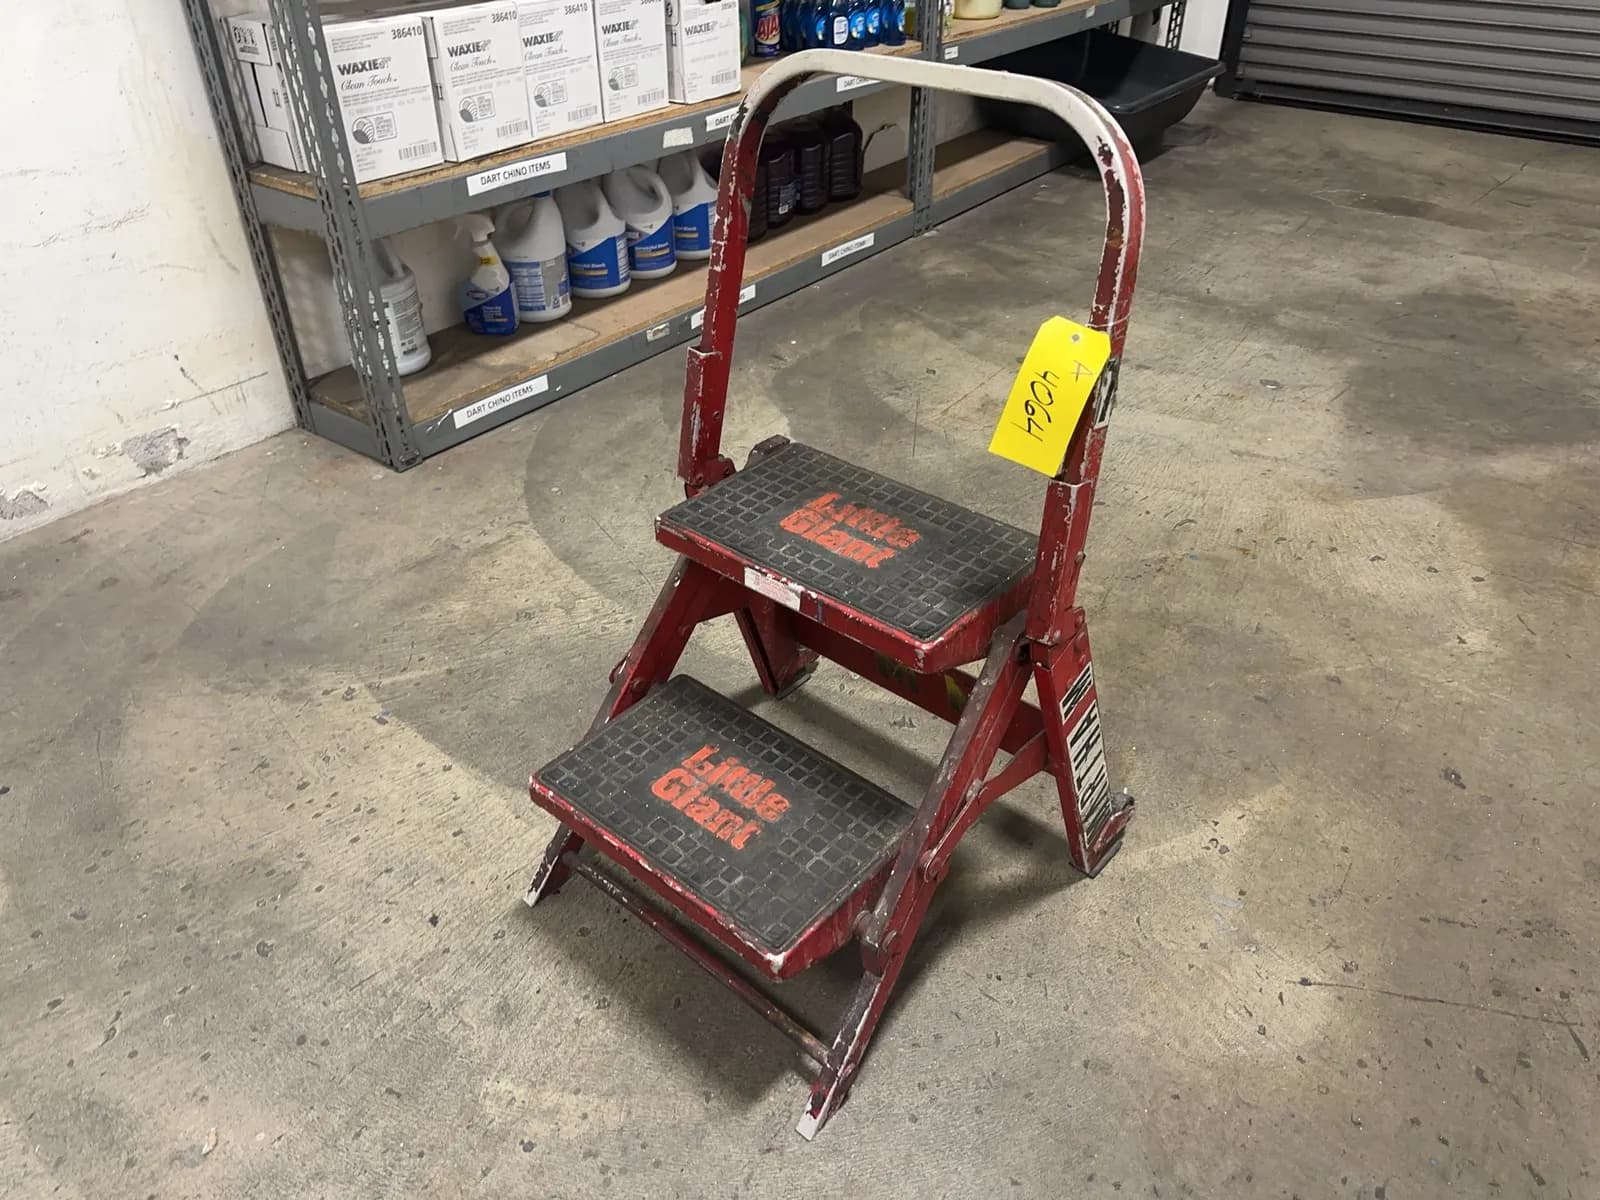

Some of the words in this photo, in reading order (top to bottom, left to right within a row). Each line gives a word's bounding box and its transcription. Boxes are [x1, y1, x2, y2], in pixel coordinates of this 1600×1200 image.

[492, 10, 517, 24] 386410
[564, 3, 588, 16] 386410
[391, 25, 422, 40] 386410
[602, 21, 630, 35] WAXIE
[685, 22, 711, 36] WAXIE
[757, 14, 779, 41] AJA
[522, 32, 554, 48] WAXIE
[447, 42, 481, 58] WAXIE
[336, 58, 380, 76] WAXIE
[341, 79, 365, 91] Clean
[367, 73, 392, 88] Touch
[715, 116, 729, 126] DART
[480, 173, 501, 185] DART
[502, 166, 527, 180] CHINO
[529, 160, 551, 173] ITEMS
[466, 404, 486, 418] DART
[487, 394, 511, 409] CHINO
[512, 385, 533, 399] ITEMS
[1011, 371, 1060, 442] 4064
[806, 491, 922, 548] Little
[779, 508, 897, 568] Giant
[681, 743, 791, 823] Little
[651, 767, 762, 850] Giant
